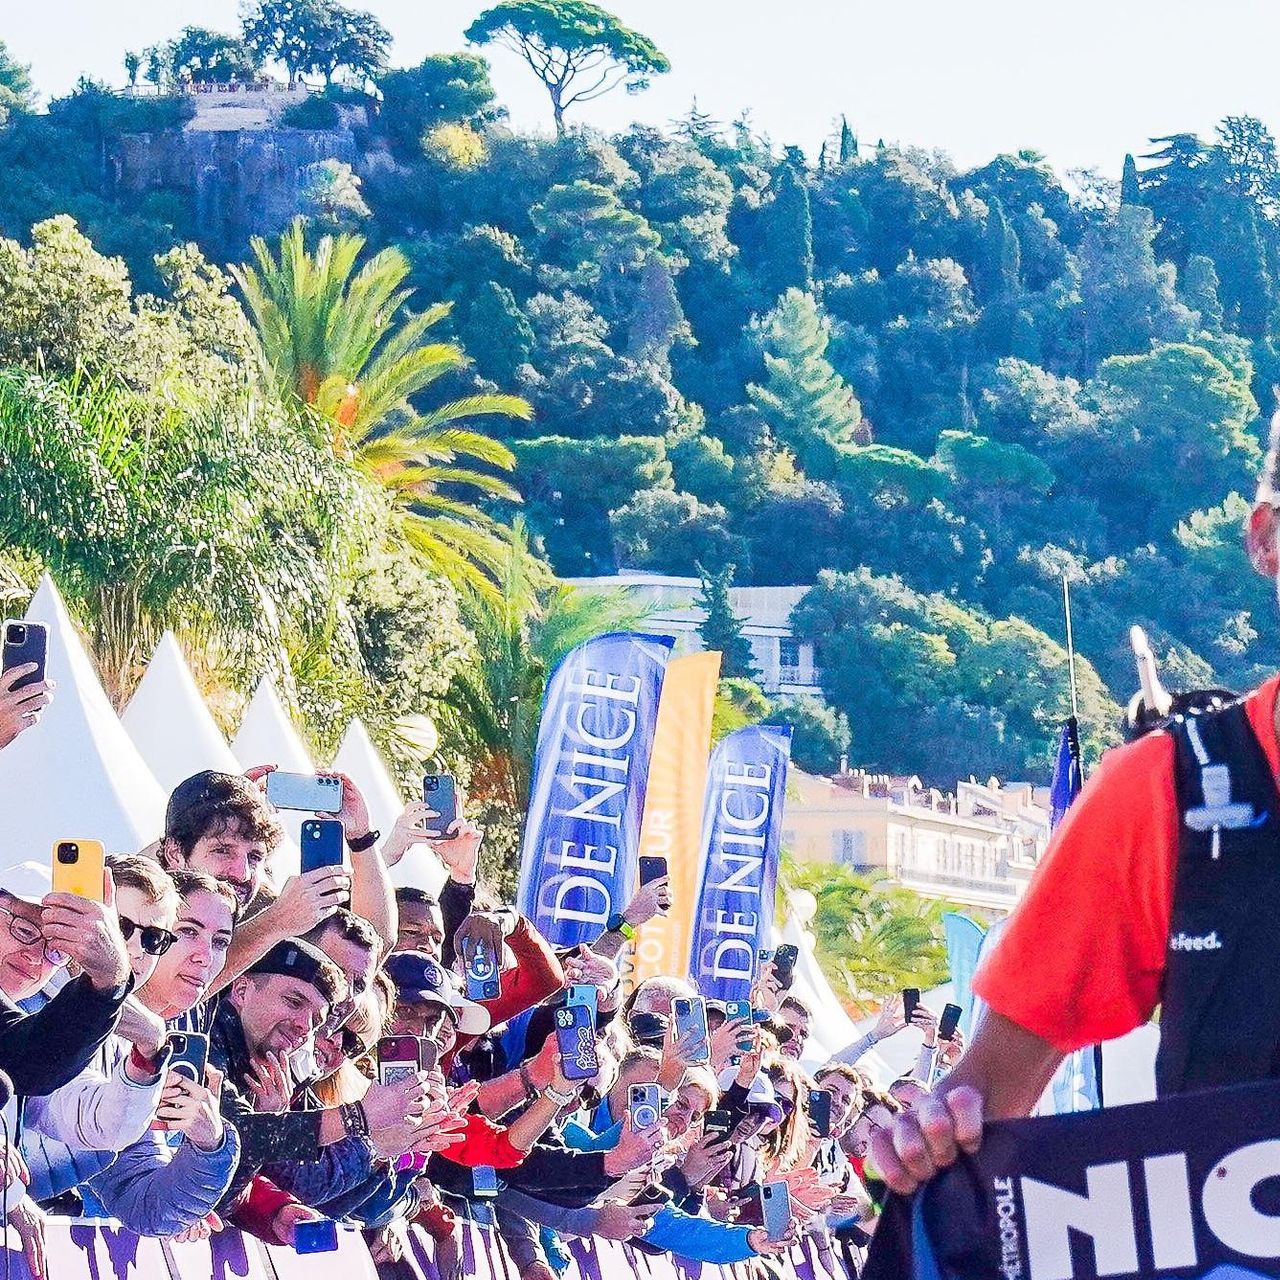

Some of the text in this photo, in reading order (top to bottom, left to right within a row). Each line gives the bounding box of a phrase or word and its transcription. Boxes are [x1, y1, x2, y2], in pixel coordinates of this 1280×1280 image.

[552, 667, 643, 929] DE NICE
[713, 759, 774, 983] DE NICE
